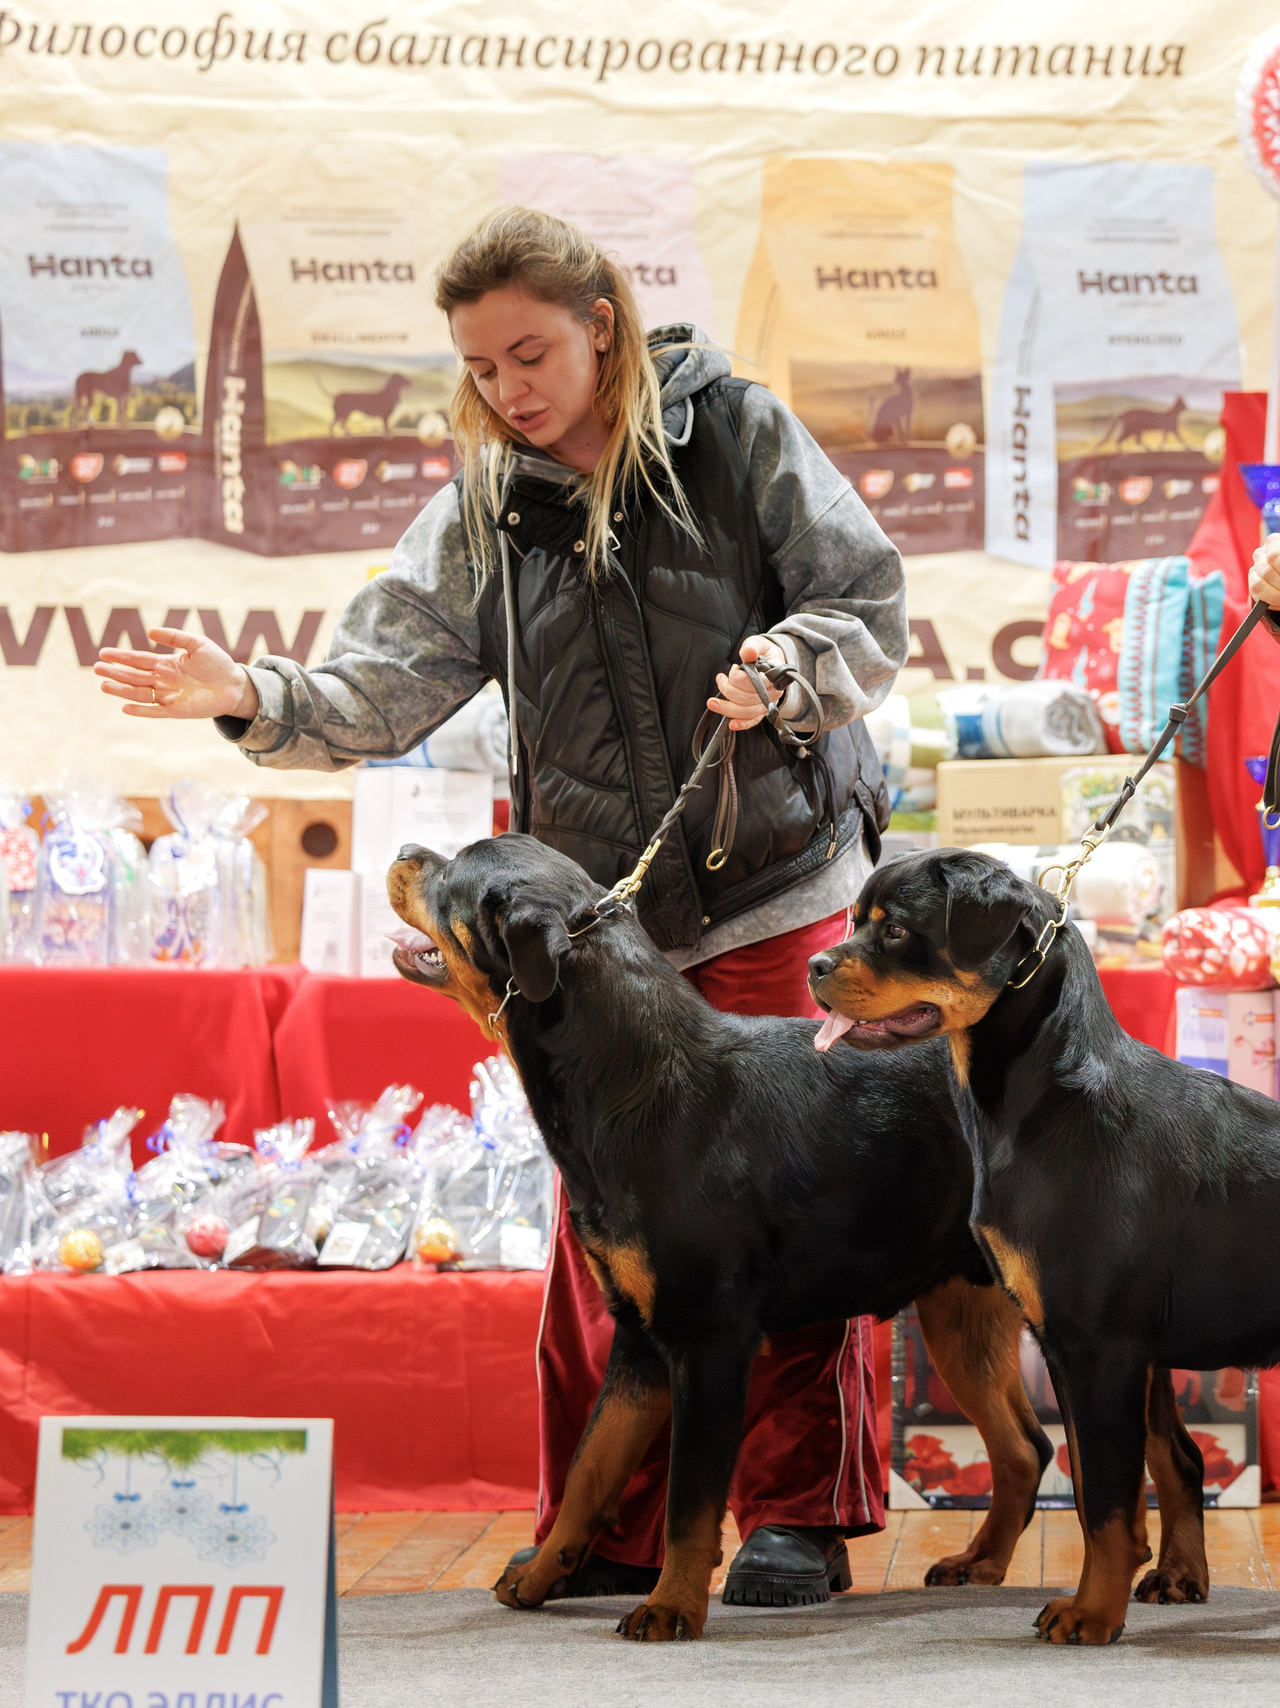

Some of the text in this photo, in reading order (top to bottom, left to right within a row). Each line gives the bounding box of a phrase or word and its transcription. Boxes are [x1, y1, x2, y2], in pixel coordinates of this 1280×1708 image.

[325, 19, 900, 83] сбалансированного
[915, 38, 1187, 78] питания
[28, 254, 154, 278] Hanta
[290, 258, 415, 283] Hanta
[816, 266, 938, 290] Hanta
[1078, 271, 1199, 295] Hanta
[222, 377, 246, 534] Hanta
[1012, 386, 1032, 541] Hanta
[65, 1585, 285, 1655] ЛПП
